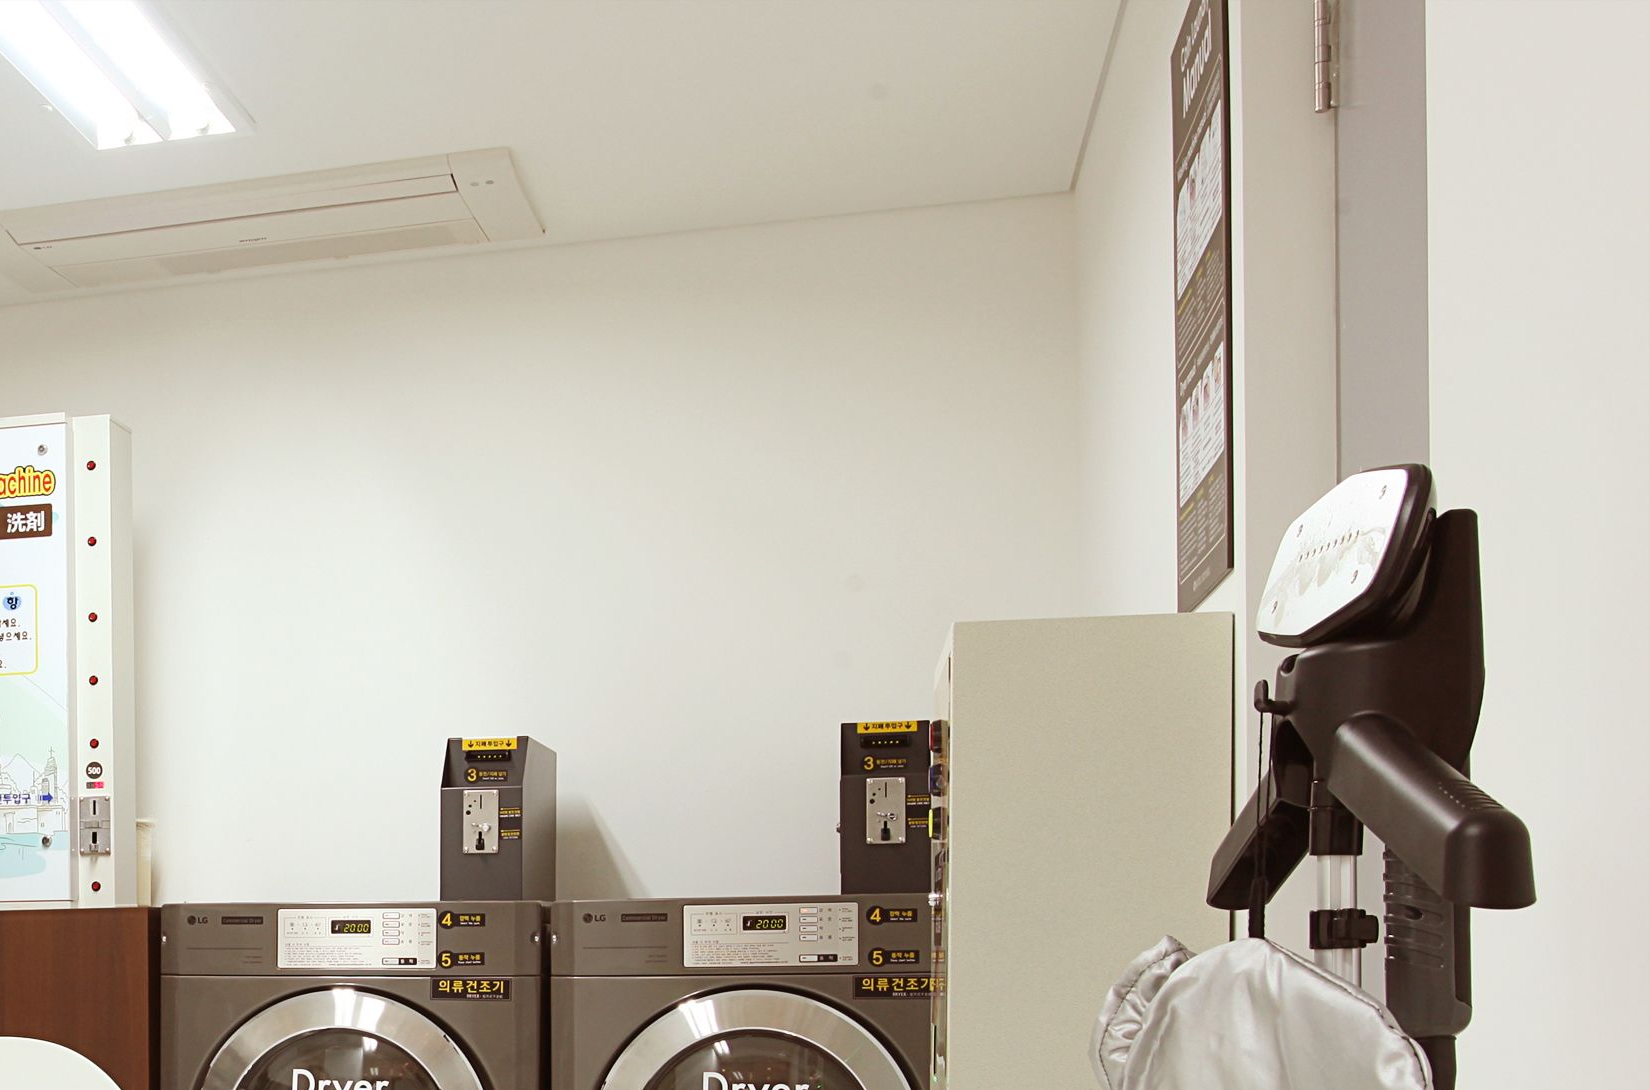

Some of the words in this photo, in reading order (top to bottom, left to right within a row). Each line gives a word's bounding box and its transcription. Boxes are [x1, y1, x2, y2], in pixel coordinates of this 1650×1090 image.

[1183, 8, 1211, 118] Manual
[864, 756, 874, 770] 3
[87, 767, 101, 775] 500
[467, 768, 477, 781] 3
[197, 916, 208, 924] LG
[441, 912, 452, 926] 4
[594, 914, 606, 922] LG
[870, 907, 881, 922] 4
[441, 953, 451, 966] 5
[872, 950, 883, 965] 5
[438, 980, 504, 993] 의류건조기
